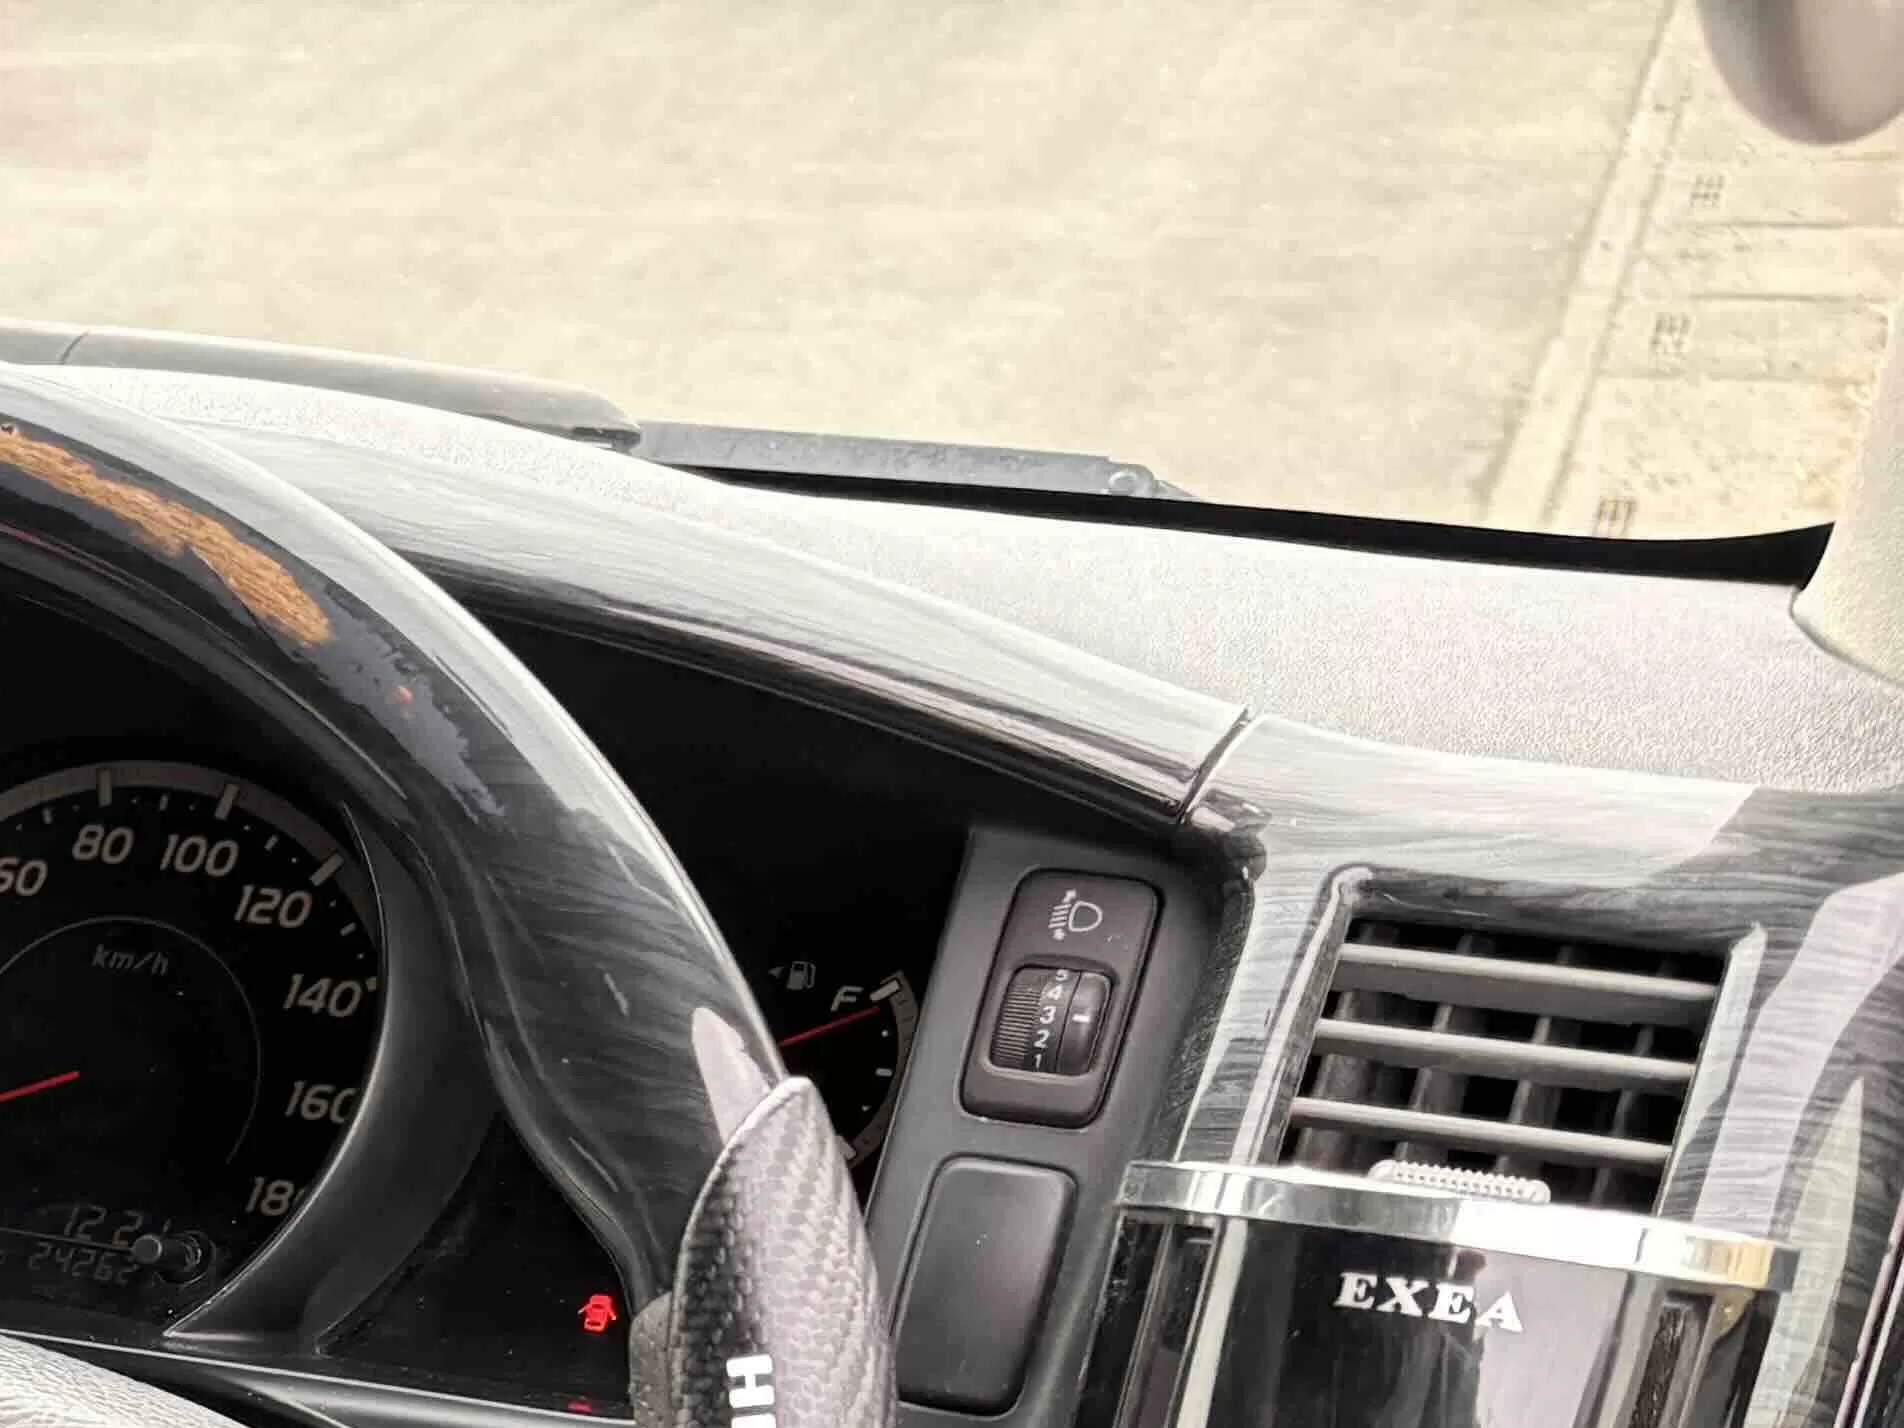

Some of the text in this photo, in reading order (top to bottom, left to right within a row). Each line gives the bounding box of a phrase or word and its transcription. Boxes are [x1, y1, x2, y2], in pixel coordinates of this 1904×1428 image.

[71, 824, 134, 865] 80
[159, 833, 238, 877] 100
[234, 885, 312, 929] 120
[92, 944, 169, 977] km/h
[283, 973, 362, 1018] 140
[829, 985, 864, 1012] F
[1048, 985, 1063, 1000] 4
[1039, 1005, 1056, 1024] 3
[1033, 1029, 1050, 1049] 2
[1034, 1053, 1042, 1069] 1
[245, 1177, 304, 1216] 18
[1332, 1271, 1524, 1334] EXEA
